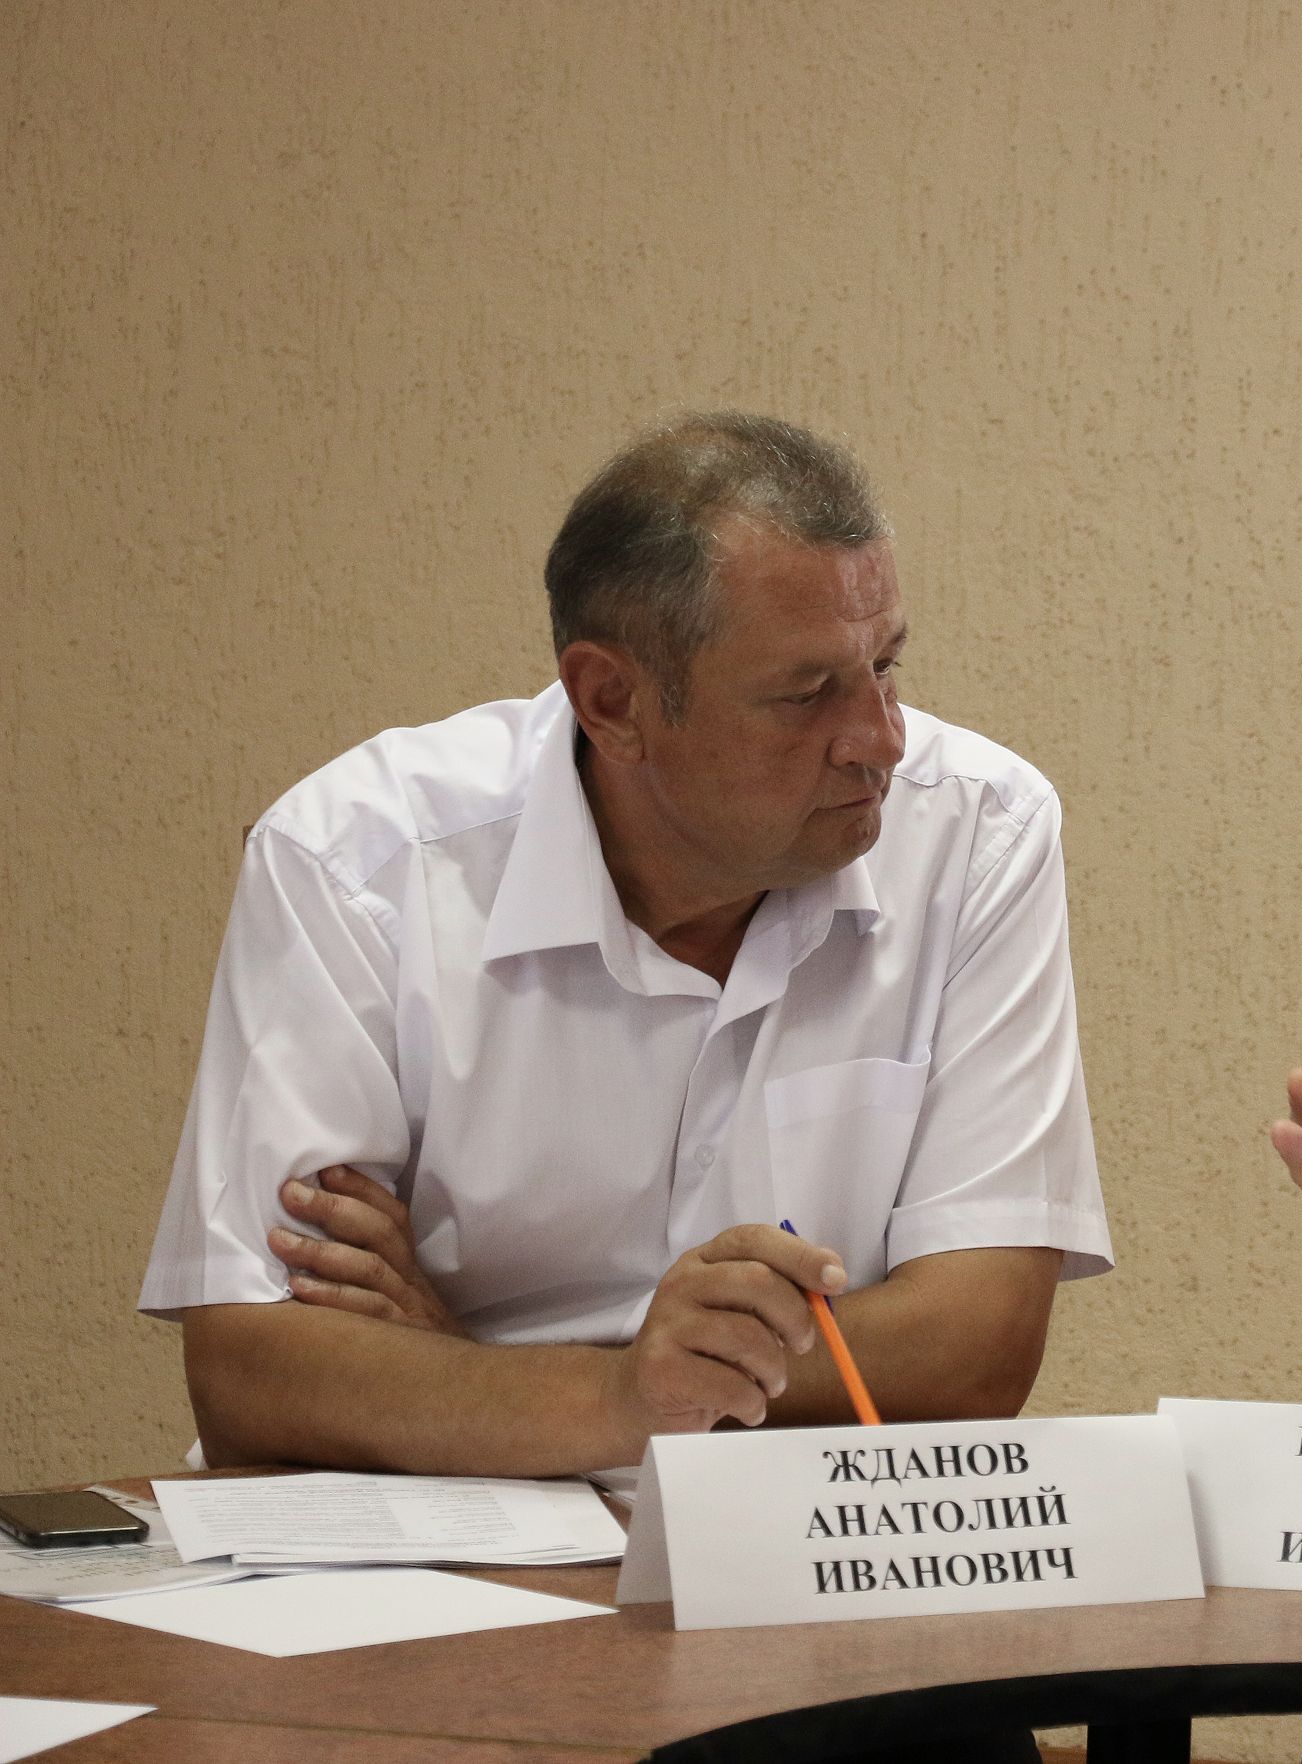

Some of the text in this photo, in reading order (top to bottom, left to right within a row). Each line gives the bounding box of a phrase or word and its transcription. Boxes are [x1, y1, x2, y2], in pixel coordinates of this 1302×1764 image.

[823, 1442, 1030, 1488] ЖДАНОВ
[806, 1485, 1071, 1539] АНАТОЛИЙ
[811, 1547, 1078, 1594] ИВАНОВИЧ
